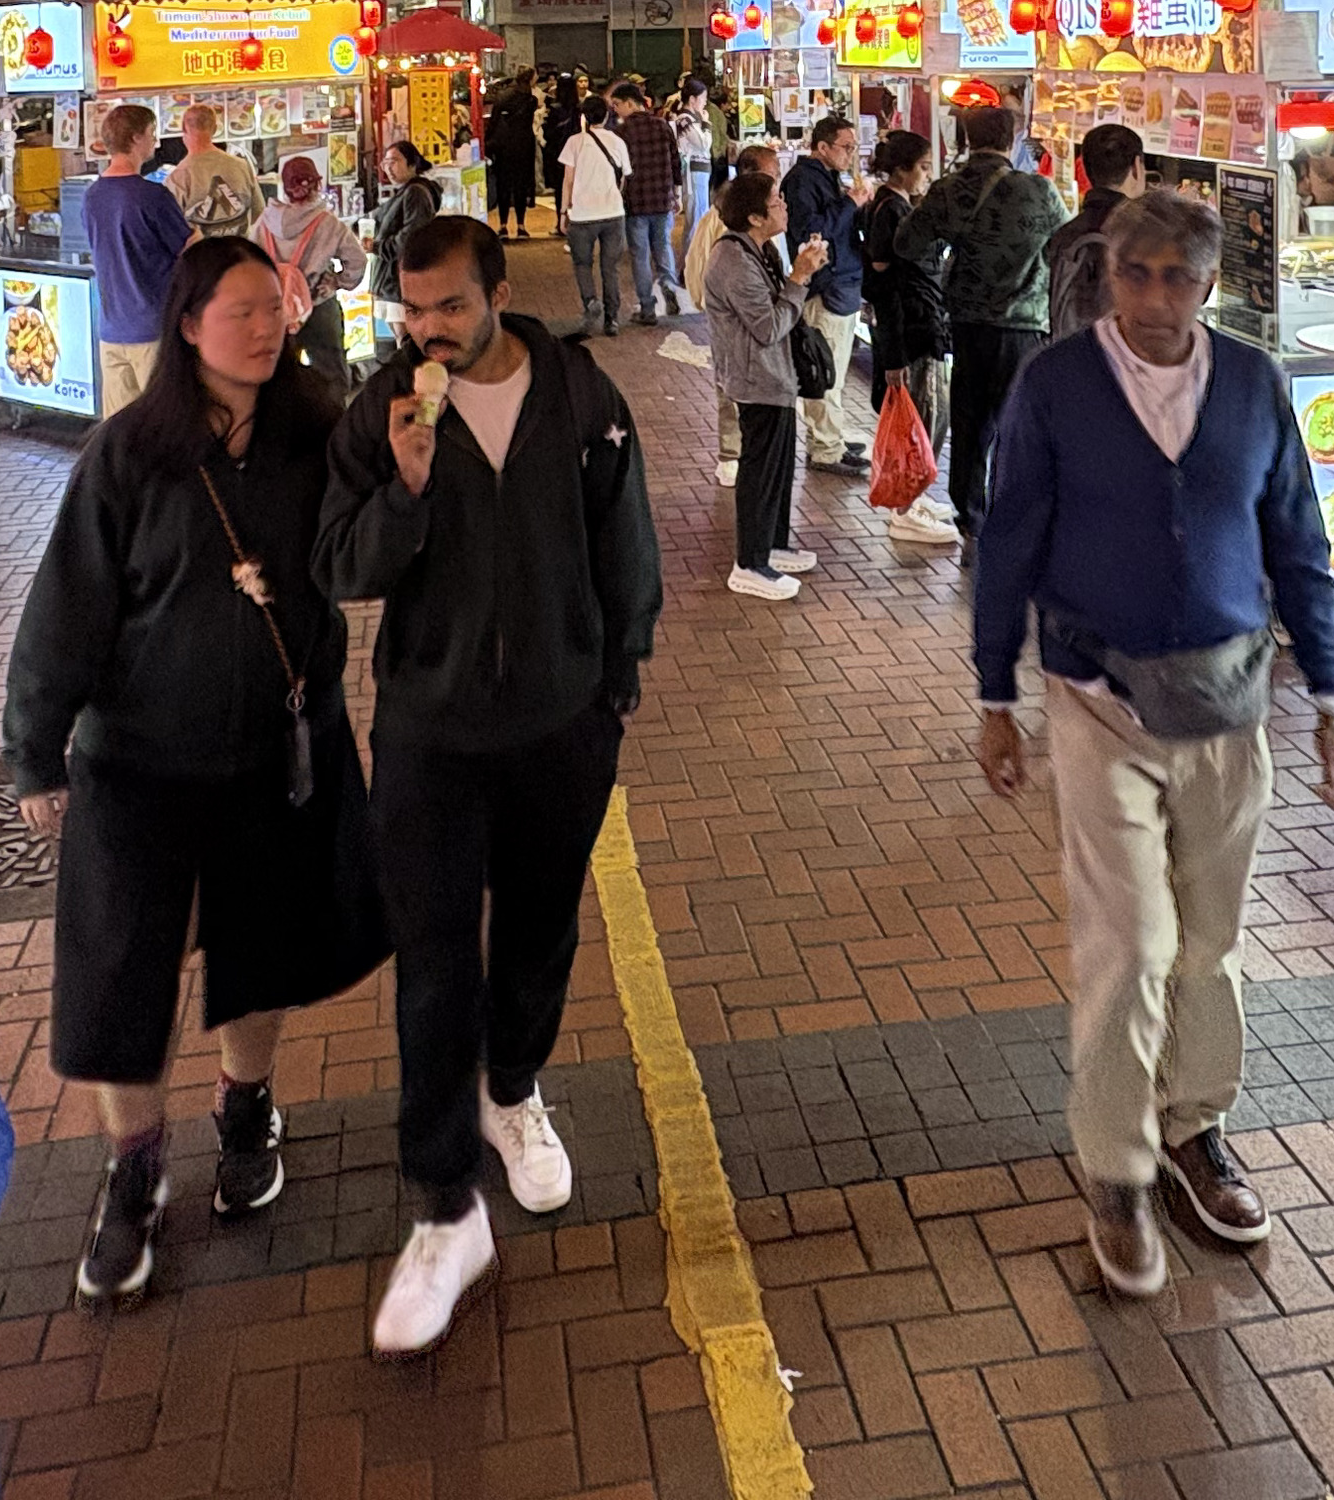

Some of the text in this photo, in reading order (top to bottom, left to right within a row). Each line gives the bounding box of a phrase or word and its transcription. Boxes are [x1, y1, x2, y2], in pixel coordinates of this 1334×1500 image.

[269, 26, 299, 38] Food
[183, 48, 288, 75] 地中海食
